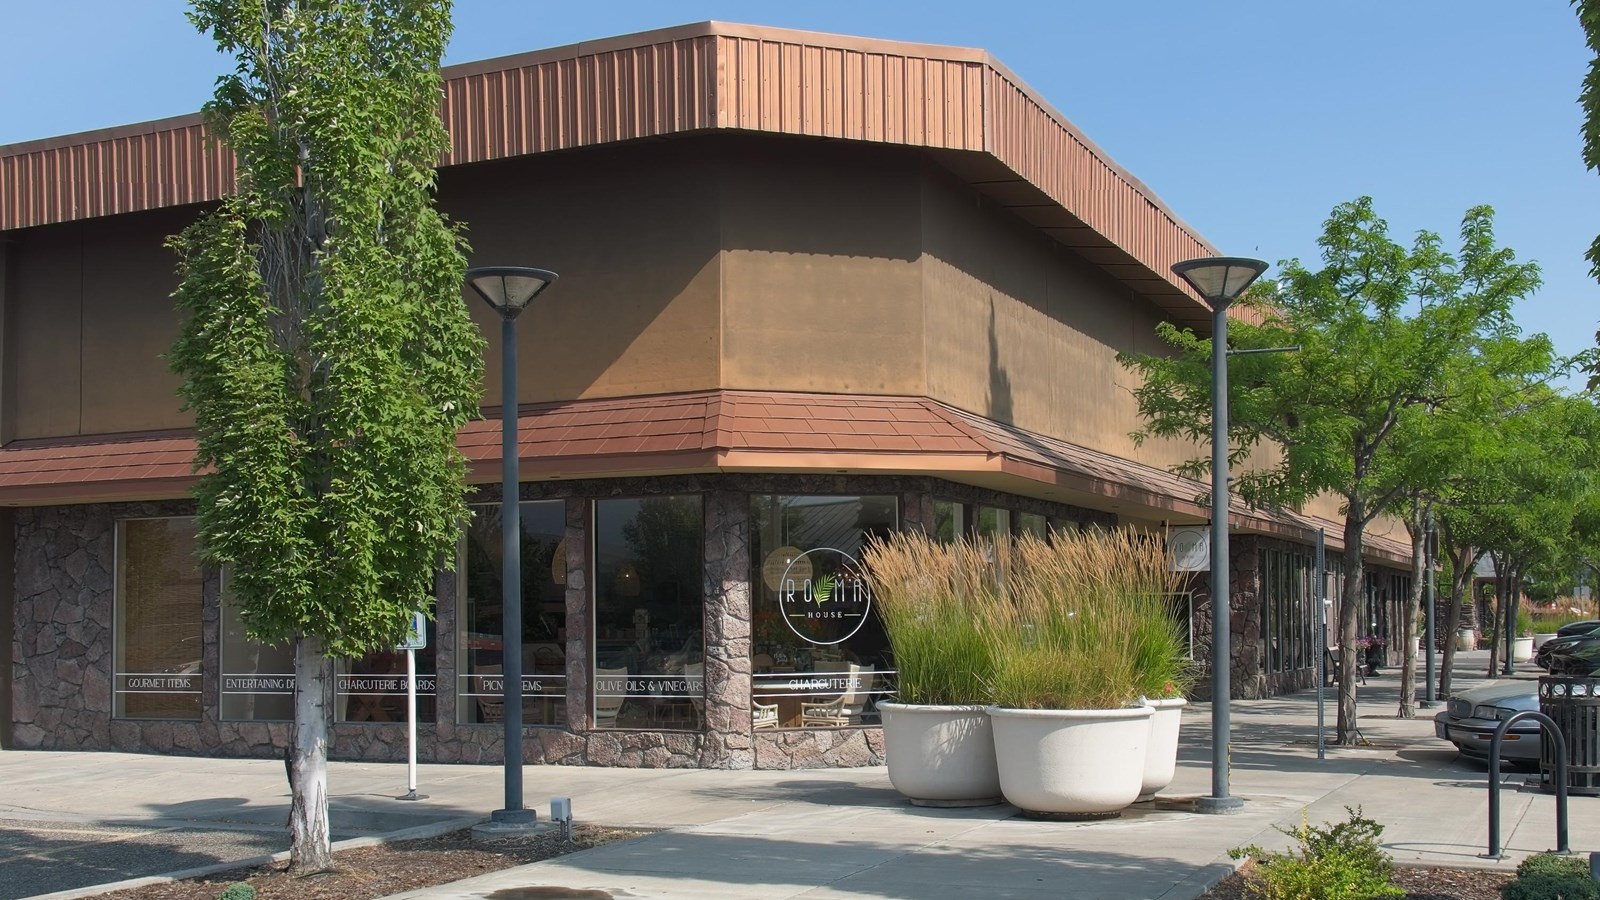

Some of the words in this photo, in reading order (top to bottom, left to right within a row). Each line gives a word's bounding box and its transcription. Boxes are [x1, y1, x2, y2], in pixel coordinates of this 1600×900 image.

[786, 579, 862, 603] ROMA
[808, 611, 842, 619] HOUSE
[128, 678, 165, 689] GOURMET
[167, 678, 191, 689] ITEMS
[226, 678, 285, 689] ENTERTAINING
[338, 679, 398, 690] CHARCUTERIE
[596, 680, 623, 691] OLIVE
[625, 680, 646, 692] OILS
[647, 680, 656, 692] &
[658, 680, 704, 692] VINEGARS
[788, 677, 863, 691] CHARCUTERIE
